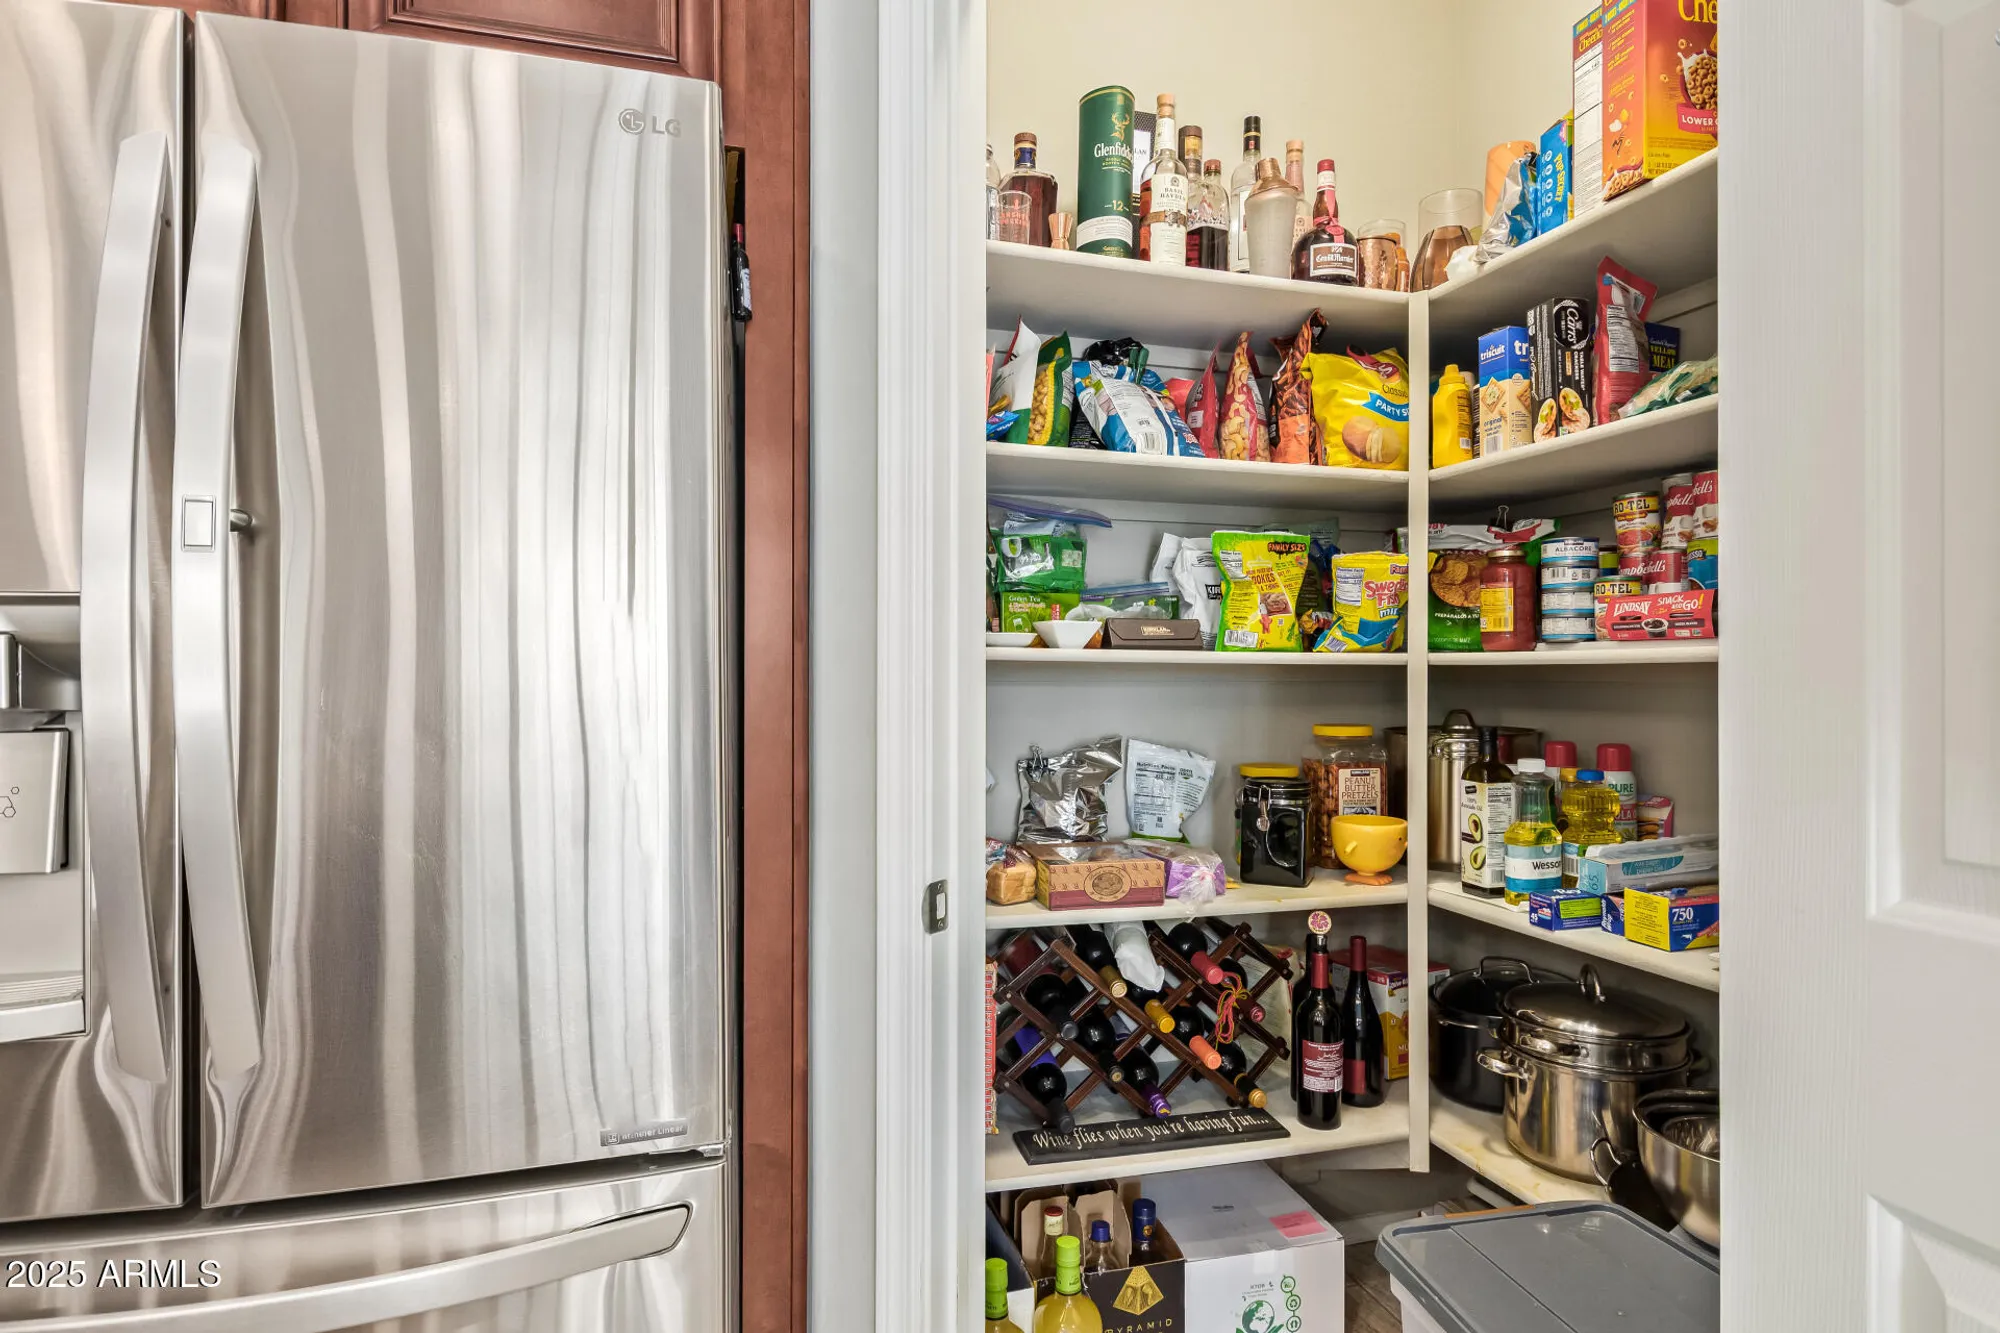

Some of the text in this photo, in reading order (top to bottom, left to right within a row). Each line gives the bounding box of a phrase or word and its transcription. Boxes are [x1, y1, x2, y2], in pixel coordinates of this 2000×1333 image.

[1678, 0, 1717, 24] Che
[1681, 114, 1713, 126] LOWER
[652, 116, 681, 138] LG
[1113, 200, 1124, 211] 12
[1480, 344, 1505, 361] triscuit
[1375, 399, 1401, 416] PARTY
[1268, 543, 1290, 551] FAMILY
[1657, 594, 1684, 606] SNACK
[1344, 776, 1376, 785] PEANUT
[1608, 783, 1634, 793] PURE
[1342, 791, 1379, 799] PRETZELS
[1589, 875, 1599, 890] 65
[1671, 907, 1694, 922] 750
[1032, 1131, 1071, 1148] Wine
[1073, 1127, 1104, 1150] flies
[1106, 1122, 1144, 1142] when
[1144, 1120, 1185, 1141] you're
[1184, 1115, 1235, 1133] having
